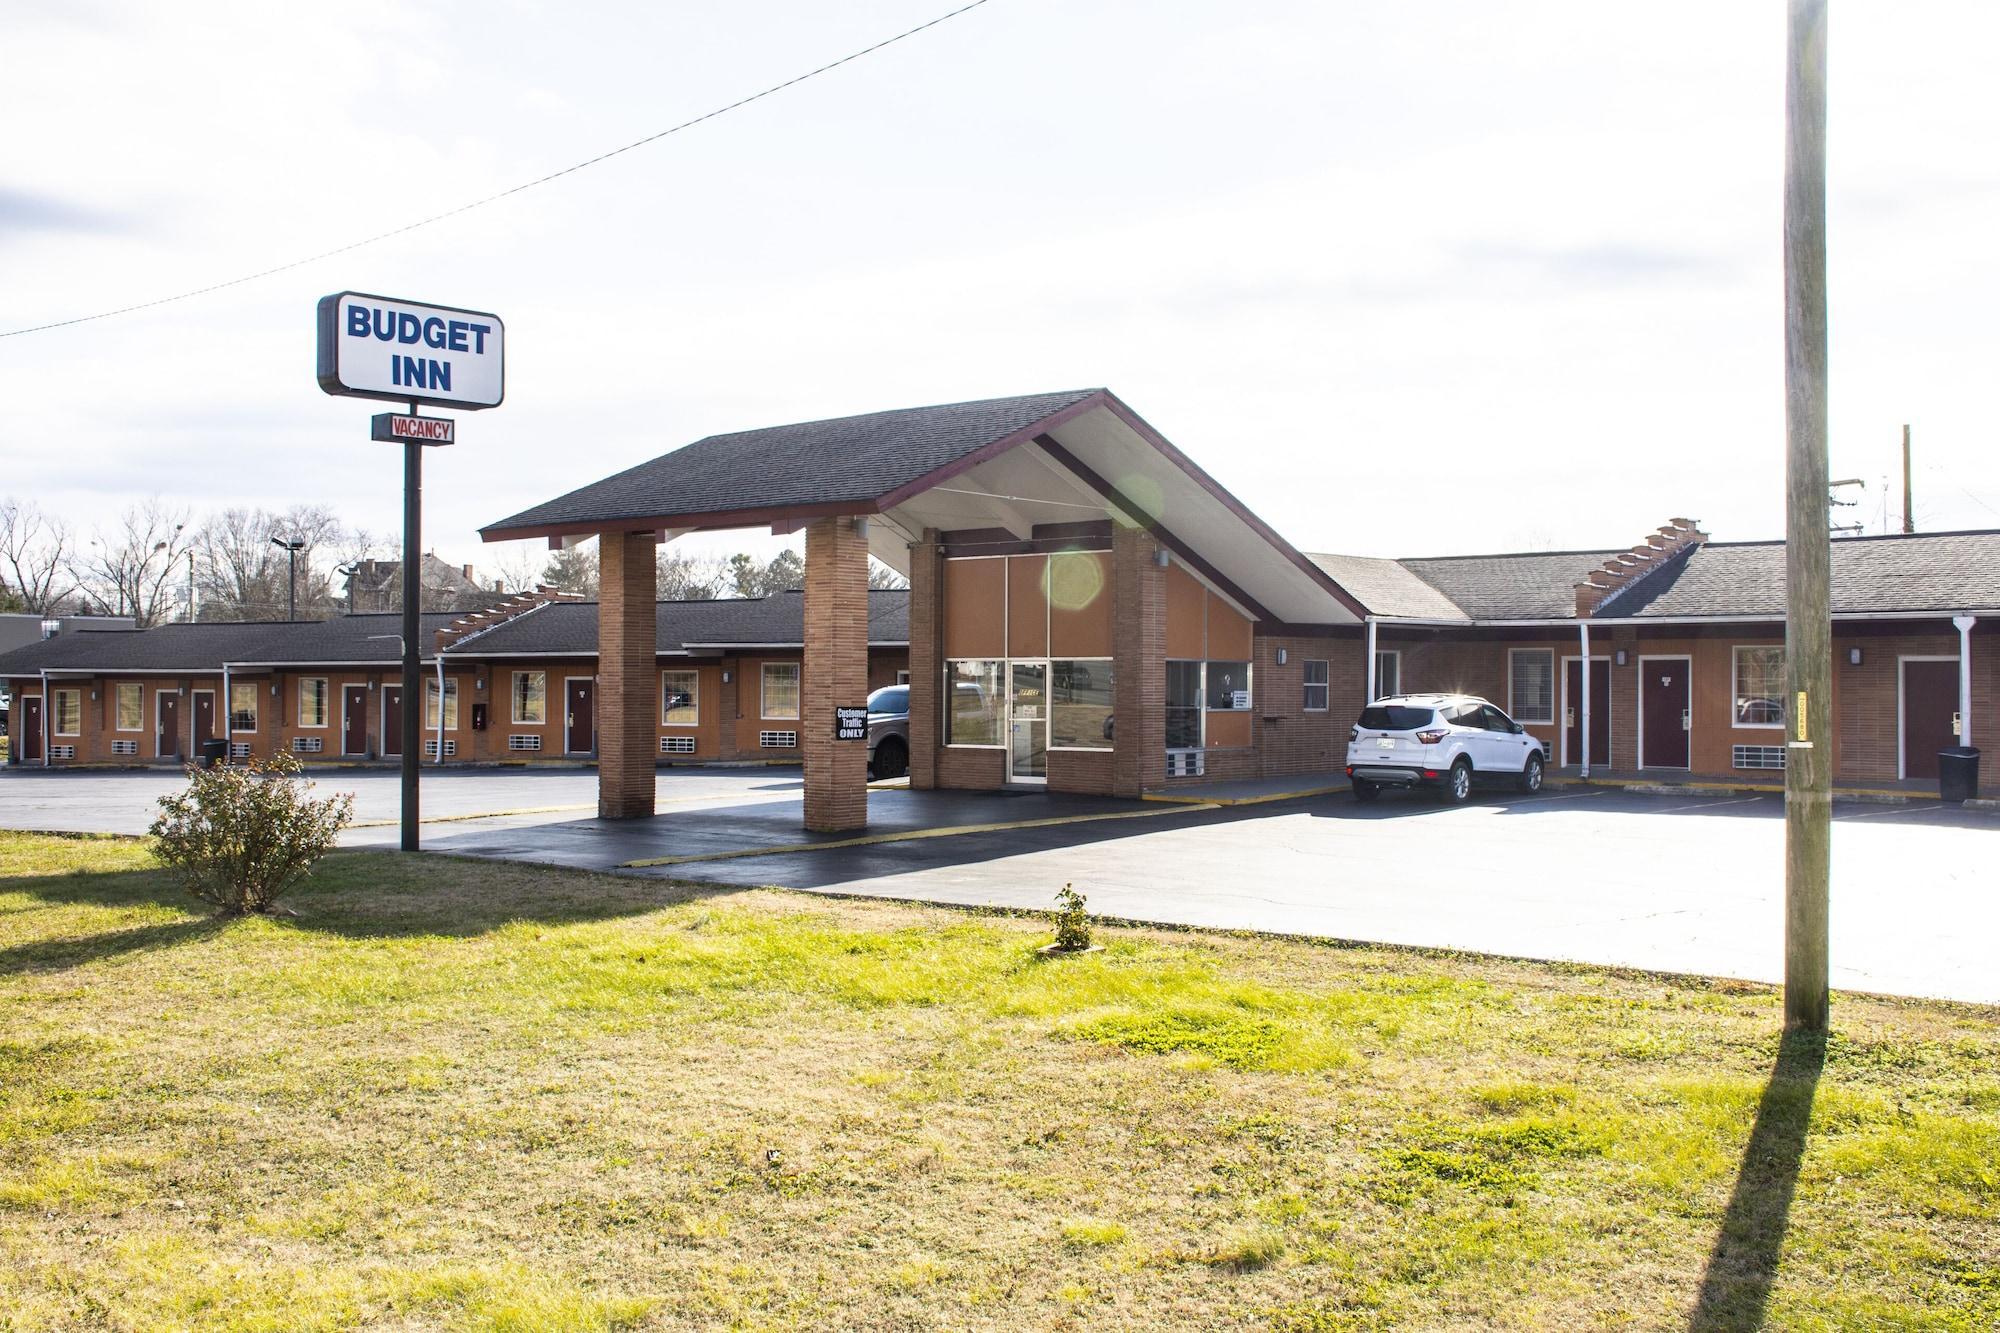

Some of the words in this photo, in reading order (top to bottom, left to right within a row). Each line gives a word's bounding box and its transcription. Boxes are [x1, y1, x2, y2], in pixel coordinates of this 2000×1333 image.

[348, 304, 491, 354] BUDGET
[392, 354, 451, 391] INN
[393, 418, 450, 440] VACANCY
[837, 708, 867, 718] Customer
[842, 718, 862, 728] Traffic
[839, 729, 864, 738] ONLY
